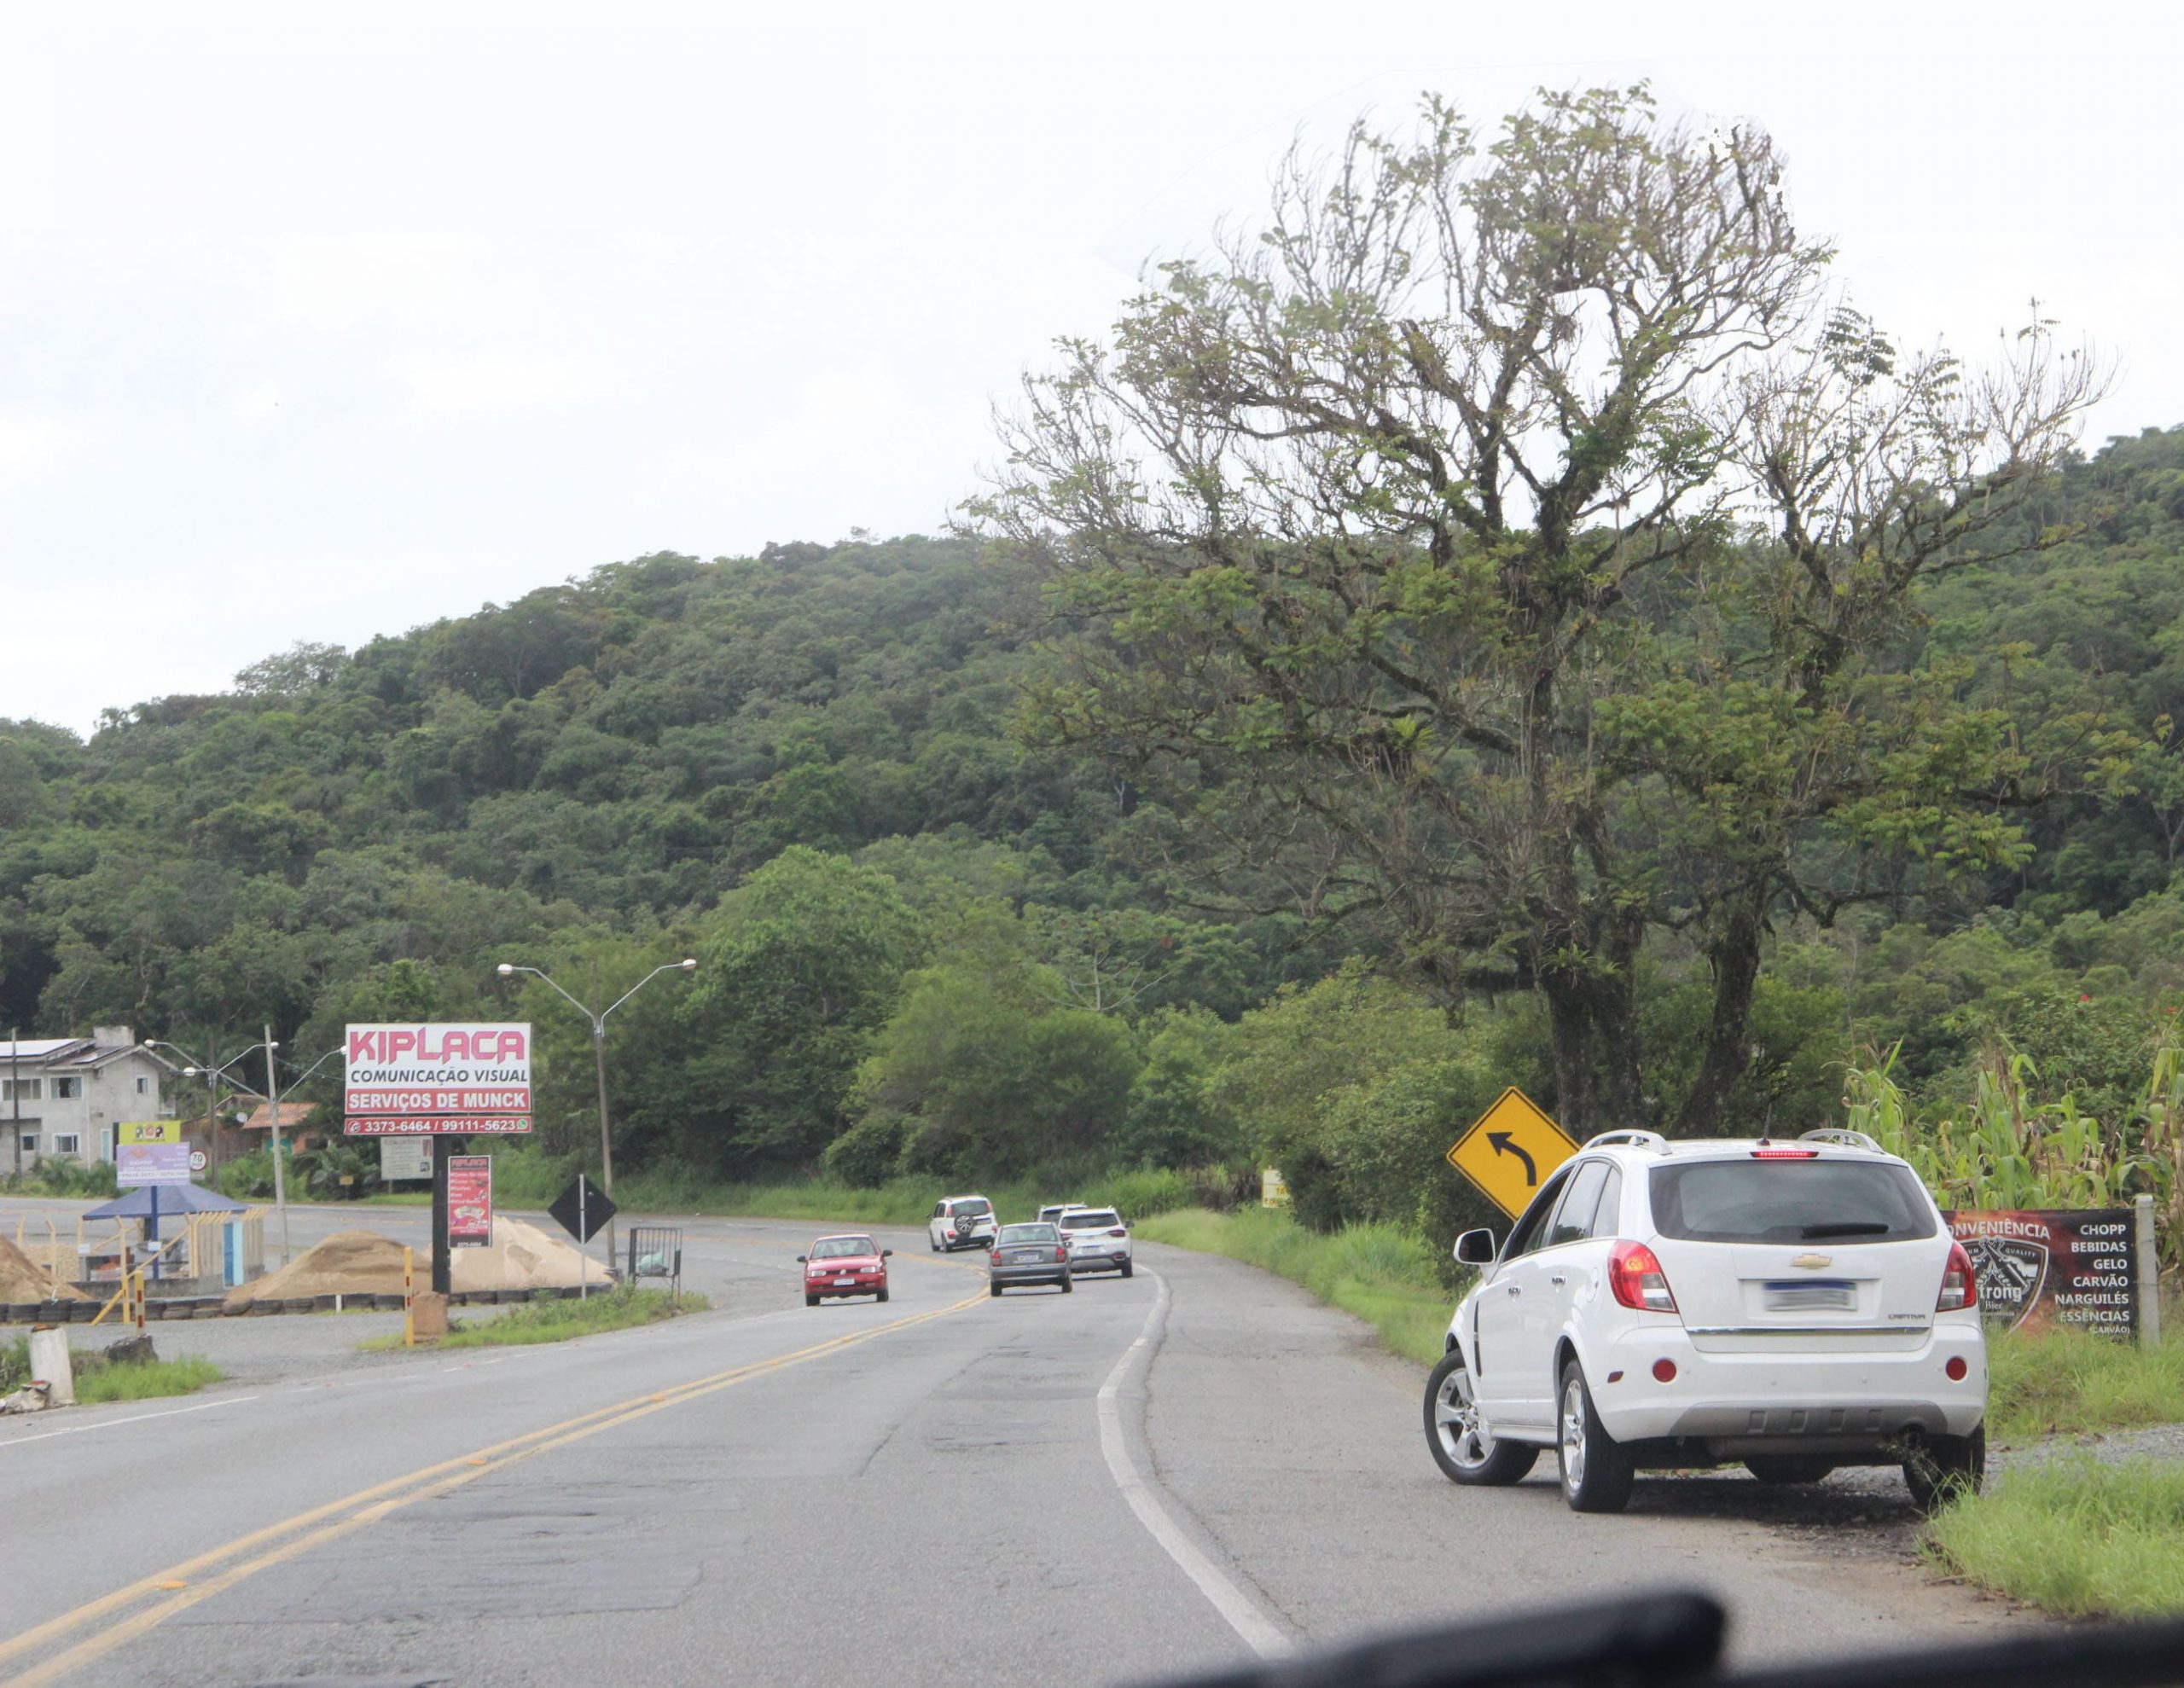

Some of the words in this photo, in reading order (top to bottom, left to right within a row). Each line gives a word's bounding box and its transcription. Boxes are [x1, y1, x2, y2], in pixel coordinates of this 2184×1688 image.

[349, 1026, 525, 1065] KIPLACA
[351, 1066, 469, 1086] COMUNICAÇÃO
[474, 1069, 528, 1082] VISUAL
[349, 1093, 433, 1111] SERVIÇOS
[437, 1093, 459, 1108] DE
[463, 1092, 526, 1107] MUNCK
[364, 1120, 431, 1132] 3373-6464
[442, 1119, 515, 1131] 99111-5623
[1947, 1218, 2051, 1241] ONVENIÊNCIA
[2080, 1224, 2127, 1235] CHOPP
[2005, 1247, 2037, 1258] QUALITY
[2071, 1241, 2128, 1253] BEBIDAS
[2093, 1258, 2129, 1270] GELO
[2072, 1273, 2129, 1288] CARVÃO
[1978, 1283, 2023, 1302] trong
[2054, 1291, 2129, 1305] NARGUILÉS
